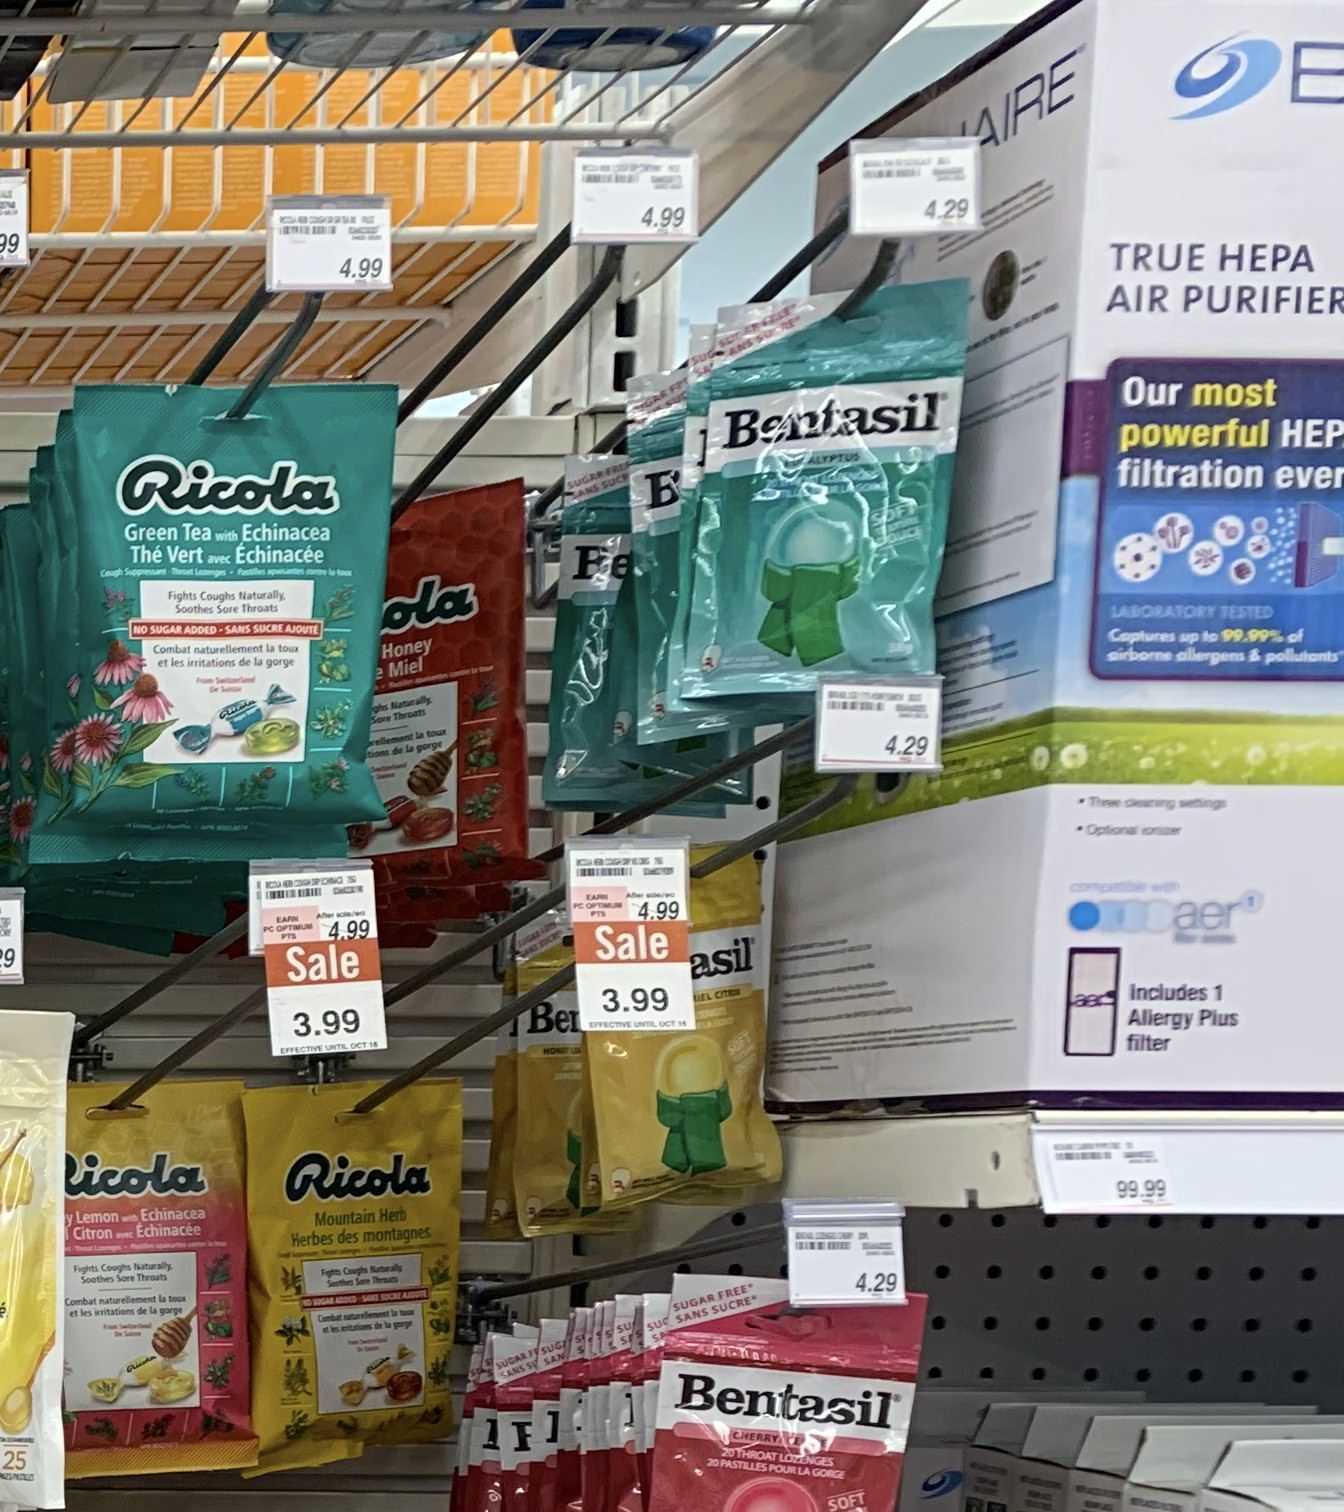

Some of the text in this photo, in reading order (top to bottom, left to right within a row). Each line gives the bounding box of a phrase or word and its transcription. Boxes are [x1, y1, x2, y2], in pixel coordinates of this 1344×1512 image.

[924, 199, 968, 220] 4.29
[1110, 243, 1315, 272] TRUE HEPA
[1106, 285, 1344, 314] AIR PURIFIER
[1121, 376, 1277, 408] Our most
[724, 392, 940, 449] Bentasil
[1119, 418, 1270, 452] powerful
[118, 457, 338, 512] Ricola
[1117, 459, 1264, 489] filtration
[125, 523, 330, 542] Green Tea with Echinacea
[131, 543, 324, 564] Thé Vert avec Échinacée
[286, 944, 360, 982] Sale
[1130, 983, 1223, 1002] Includes 1
[1128, 1008, 1239, 1029] Allergy Plus
[280, 1045, 323, 1054] EFFECTIVE
[1126, 1033, 1170, 1052] filter
[285, 1152, 431, 1201] Ricola
[1117, 1179, 1166, 1198] 99.99
[855, 1273, 897, 1293] 4.29
[675, 1373, 891, 1429] Bentasil
